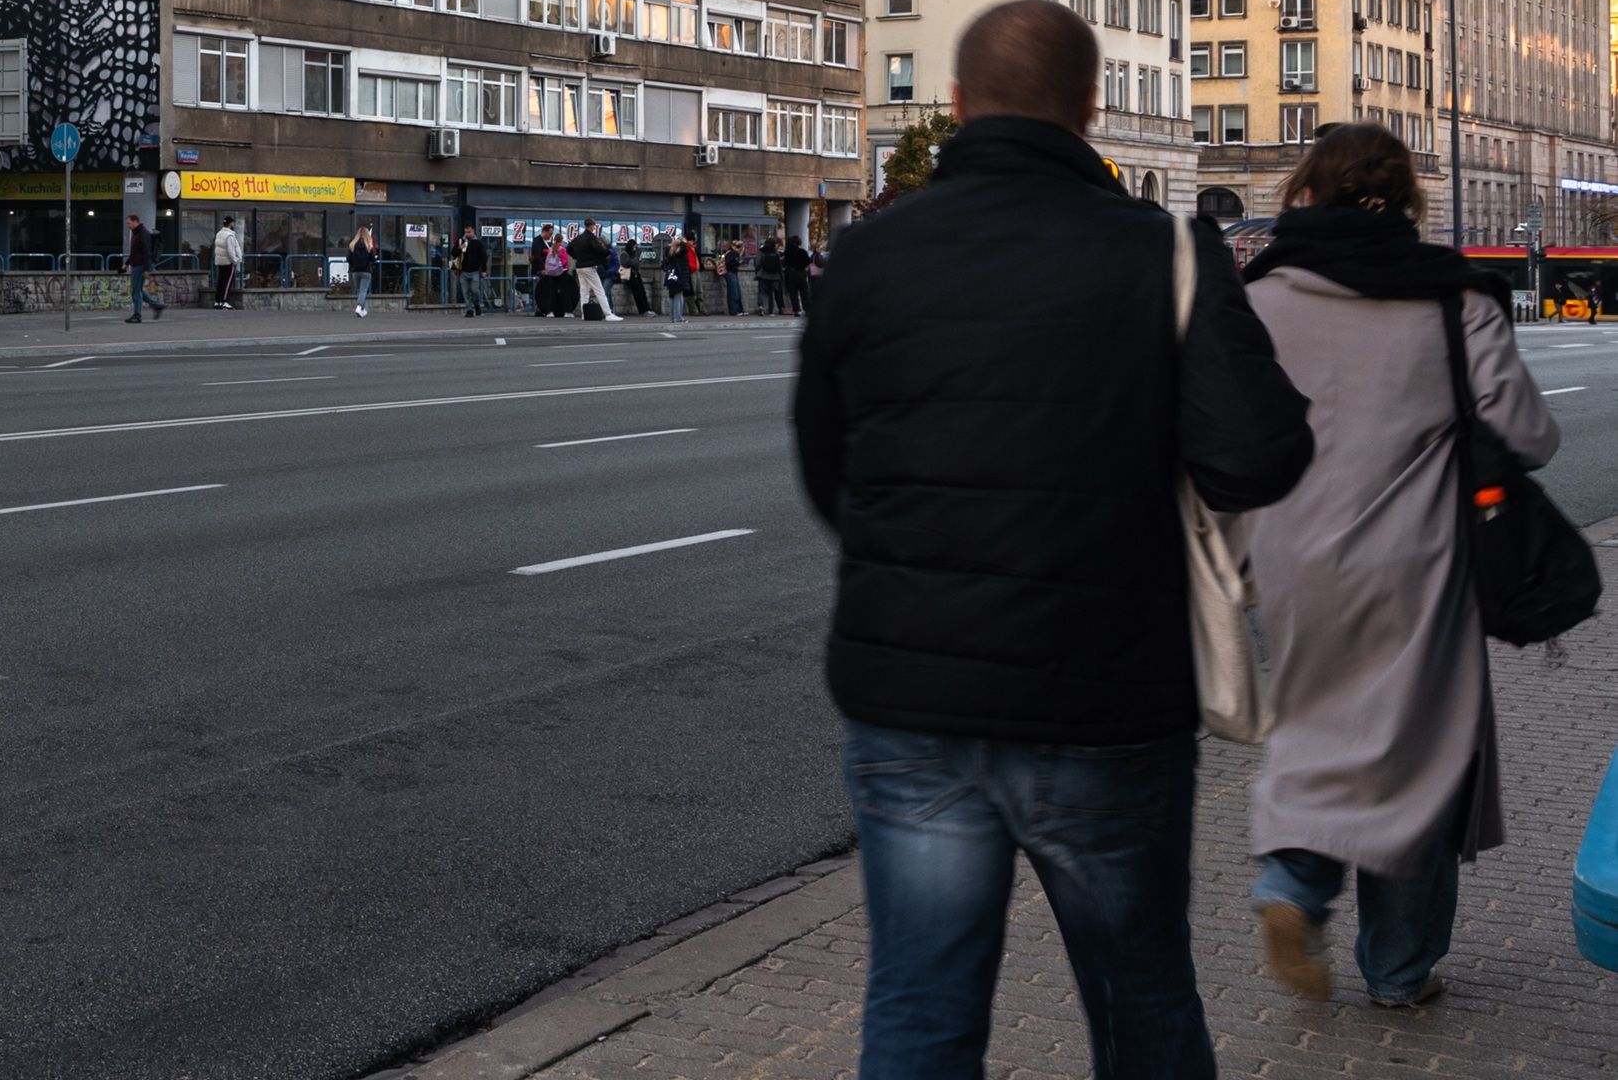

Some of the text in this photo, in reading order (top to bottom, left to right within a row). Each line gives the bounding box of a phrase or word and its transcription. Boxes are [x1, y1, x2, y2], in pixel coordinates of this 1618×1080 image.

[19, 182, 62, 194] Kuchnia
[191, 174, 239, 198] Loving
[245, 176, 270, 194] Hut
